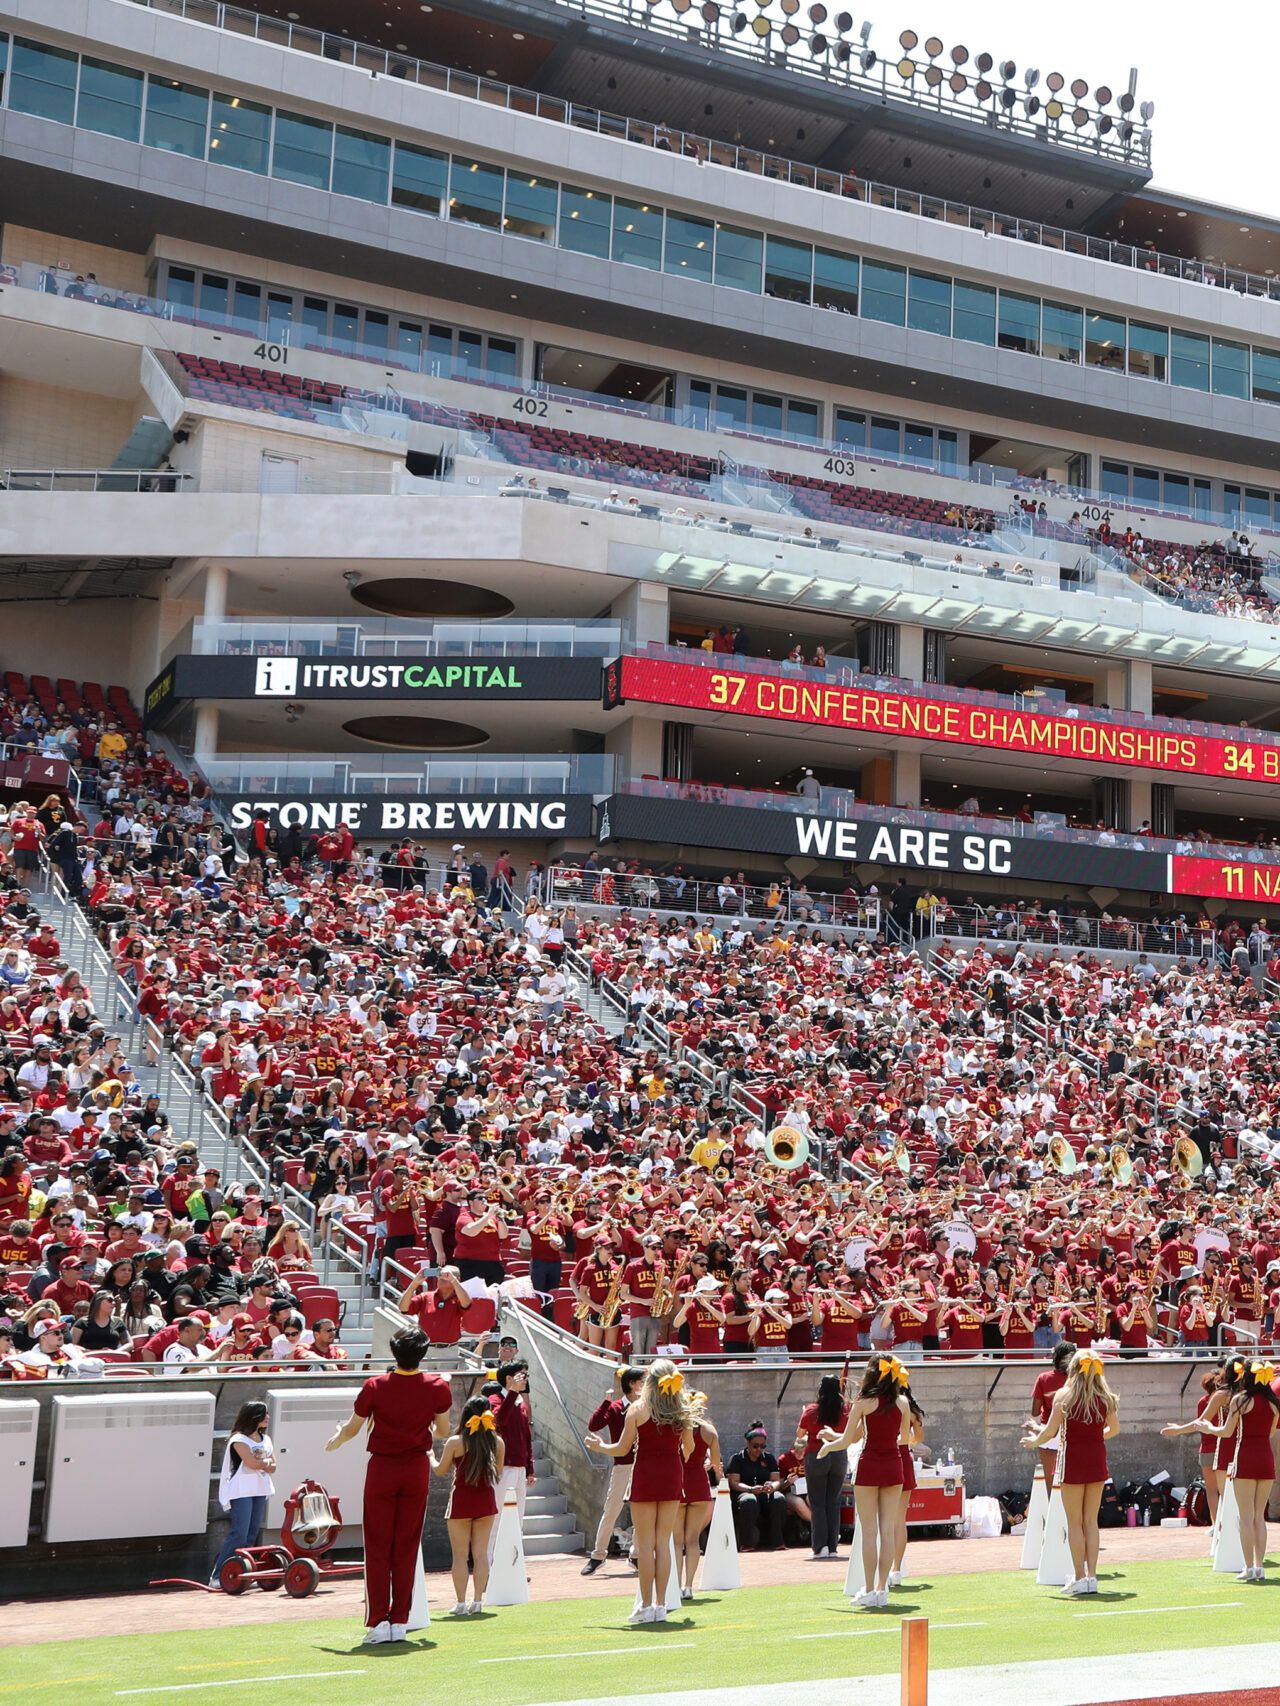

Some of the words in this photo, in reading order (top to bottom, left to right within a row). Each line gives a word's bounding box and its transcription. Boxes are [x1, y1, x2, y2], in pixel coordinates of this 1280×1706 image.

[254, 343, 289, 365] 401
[513, 397, 548, 418] 402
[823, 457, 855, 477] 403
[304, 664, 522, 688] ITRUSTCAPITAL
[709, 674, 746, 706] 37
[756, 681, 959, 736] CONFERENCE
[969, 711, 1196, 767] CHAMPIONSHIPS
[1224, 745, 1255, 774] 34
[44, 765, 54, 777] 4
[381, 801, 567, 830] BREWING
[796, 817, 857, 858] WE
[869, 826, 950, 869] ARE
[964, 835, 1011, 874] SC
[1221, 866, 1244, 893] 11
[1199, 921, 1210, 929] 15
[316, 1057, 337, 1072] 55
[2, 1250, 28, 1261] USC
[1178, 1250, 1193, 1260] USC
